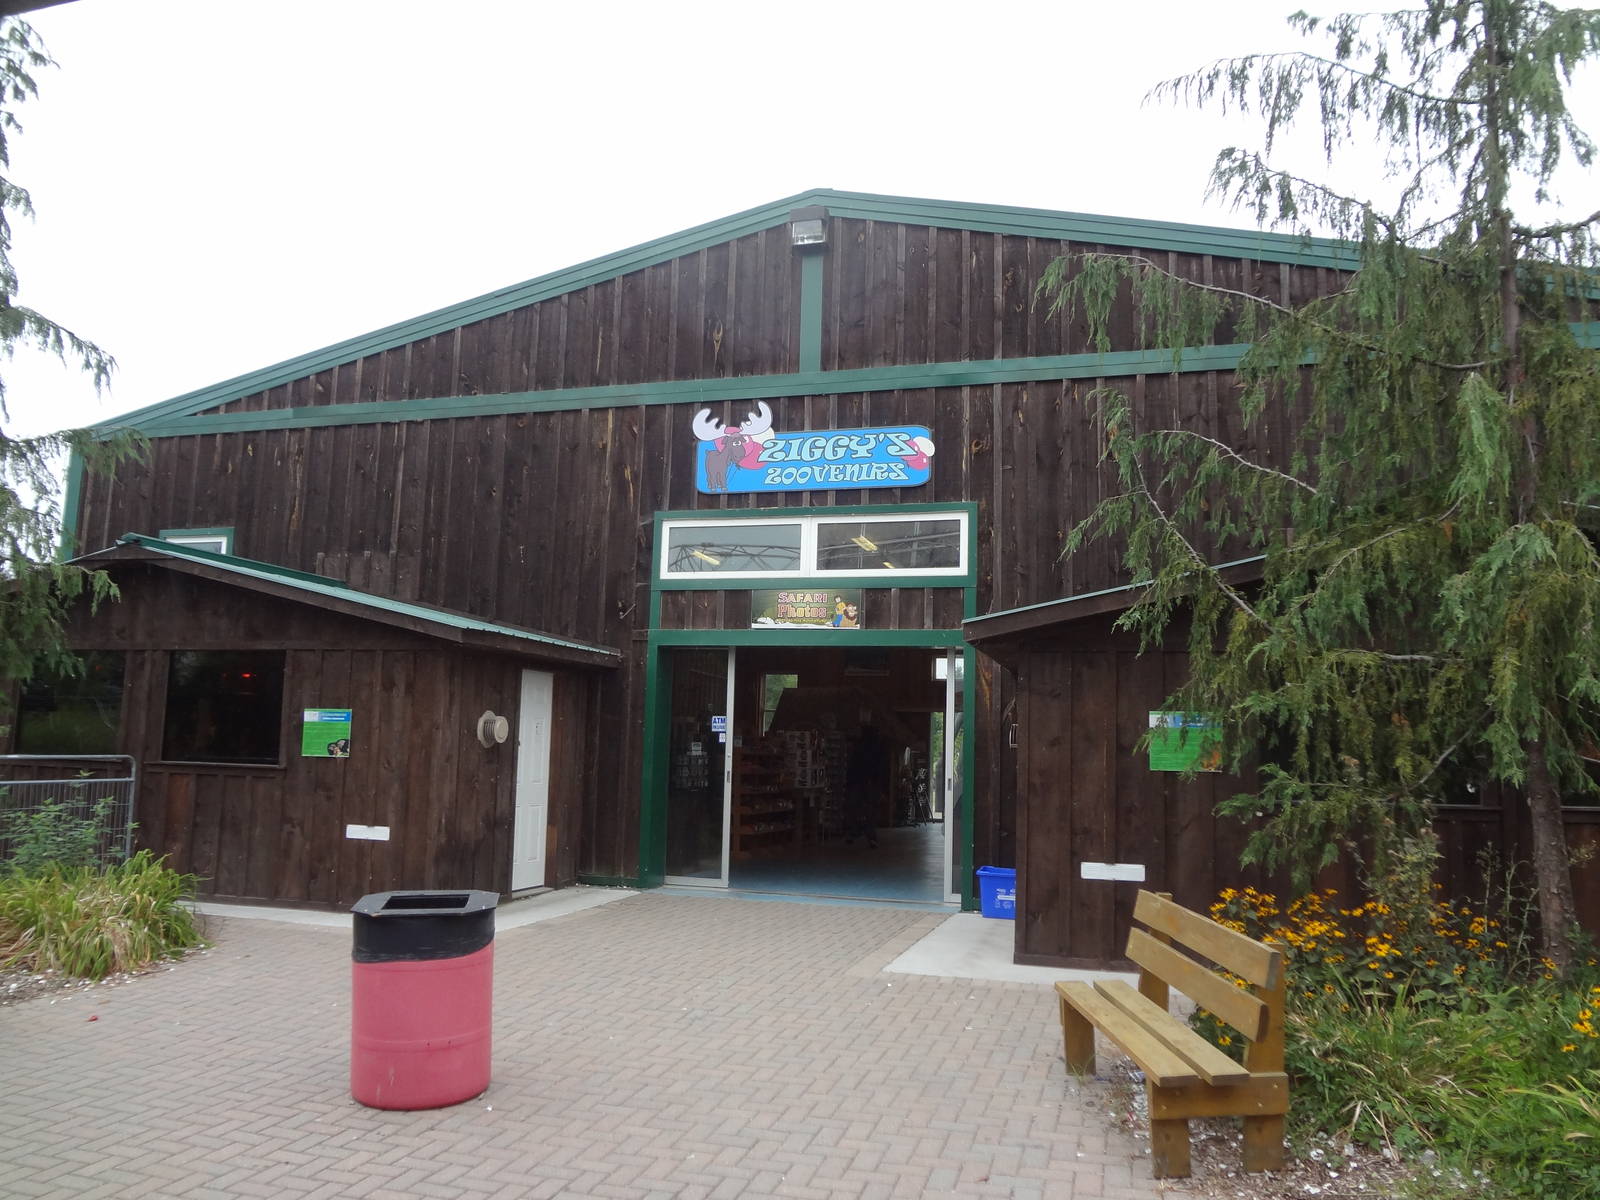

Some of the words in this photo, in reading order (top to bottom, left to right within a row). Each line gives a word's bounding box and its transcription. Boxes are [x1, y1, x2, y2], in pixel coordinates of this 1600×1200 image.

[757, 432, 918, 463] ZIGGY'S
[764, 462, 909, 485] ZOOVENIRS
[777, 592, 828, 603] SAFARI
[777, 603, 827, 618] Photos
